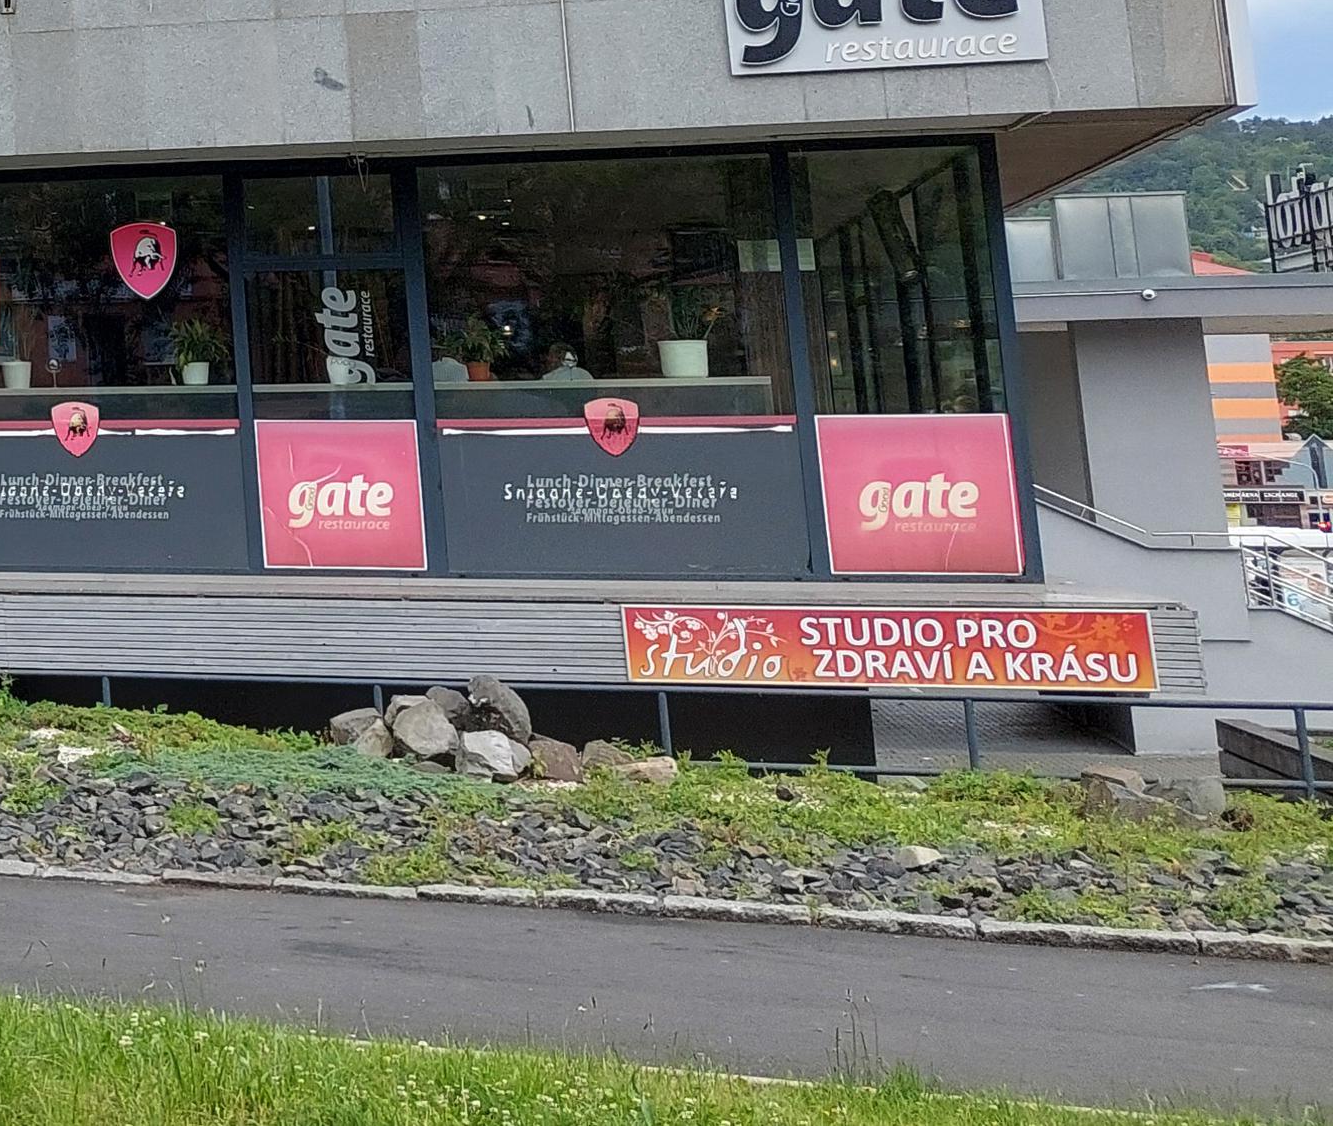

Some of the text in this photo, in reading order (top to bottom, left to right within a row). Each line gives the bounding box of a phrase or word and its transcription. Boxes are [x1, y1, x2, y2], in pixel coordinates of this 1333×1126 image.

[824, 33, 1019, 63] restaurace
[314, 286, 376, 384] gate
[361, 290, 375, 358] restaurace
[288, 474, 393, 528] gate
[318, 519, 391, 530] restaurace
[859, 473, 980, 531] gate
[894, 521, 977, 533] restaurace
[640, 618, 783, 679] studio
[800, 616, 1037, 650] STUDIO PRO
[813, 642, 1137, 684] ZDRAVÍ A KRÁSU
